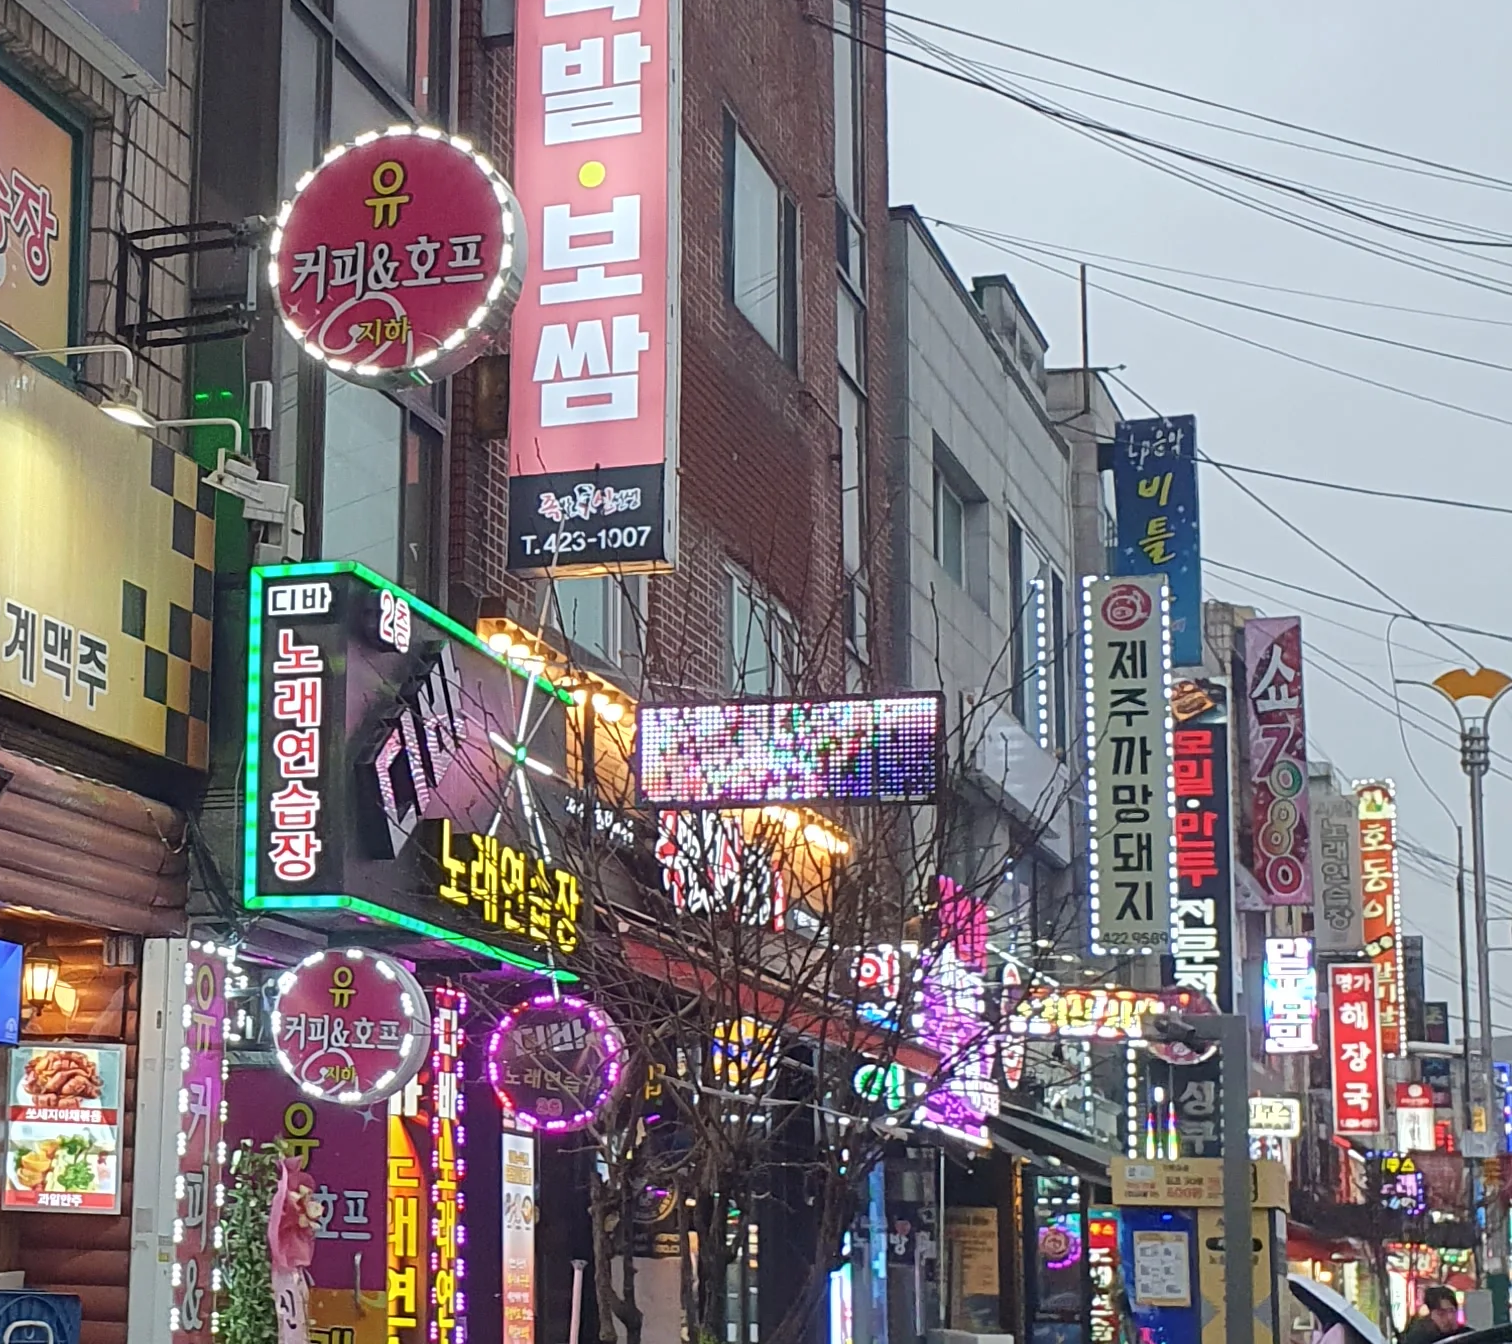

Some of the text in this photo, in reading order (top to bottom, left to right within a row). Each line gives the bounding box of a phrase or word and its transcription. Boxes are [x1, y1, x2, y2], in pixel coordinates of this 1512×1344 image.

[364, 161, 410, 228] 유
[290, 234, 484, 303] 커피&호프
[356, 316, 412, 346] 지하
[267, 582, 332, 616] 디바
[268, 628, 324, 881] 노래연습장
[1107, 640, 1154, 921] 제주까망돼지
[439, 818, 582, 953] 노래연습장
[328, 966, 356, 1008] 유
[1335, 973, 1372, 992] 명가
[284, 1013, 400, 1051] 커피&호프
[1339, 1001, 1373, 1112] 해장국
